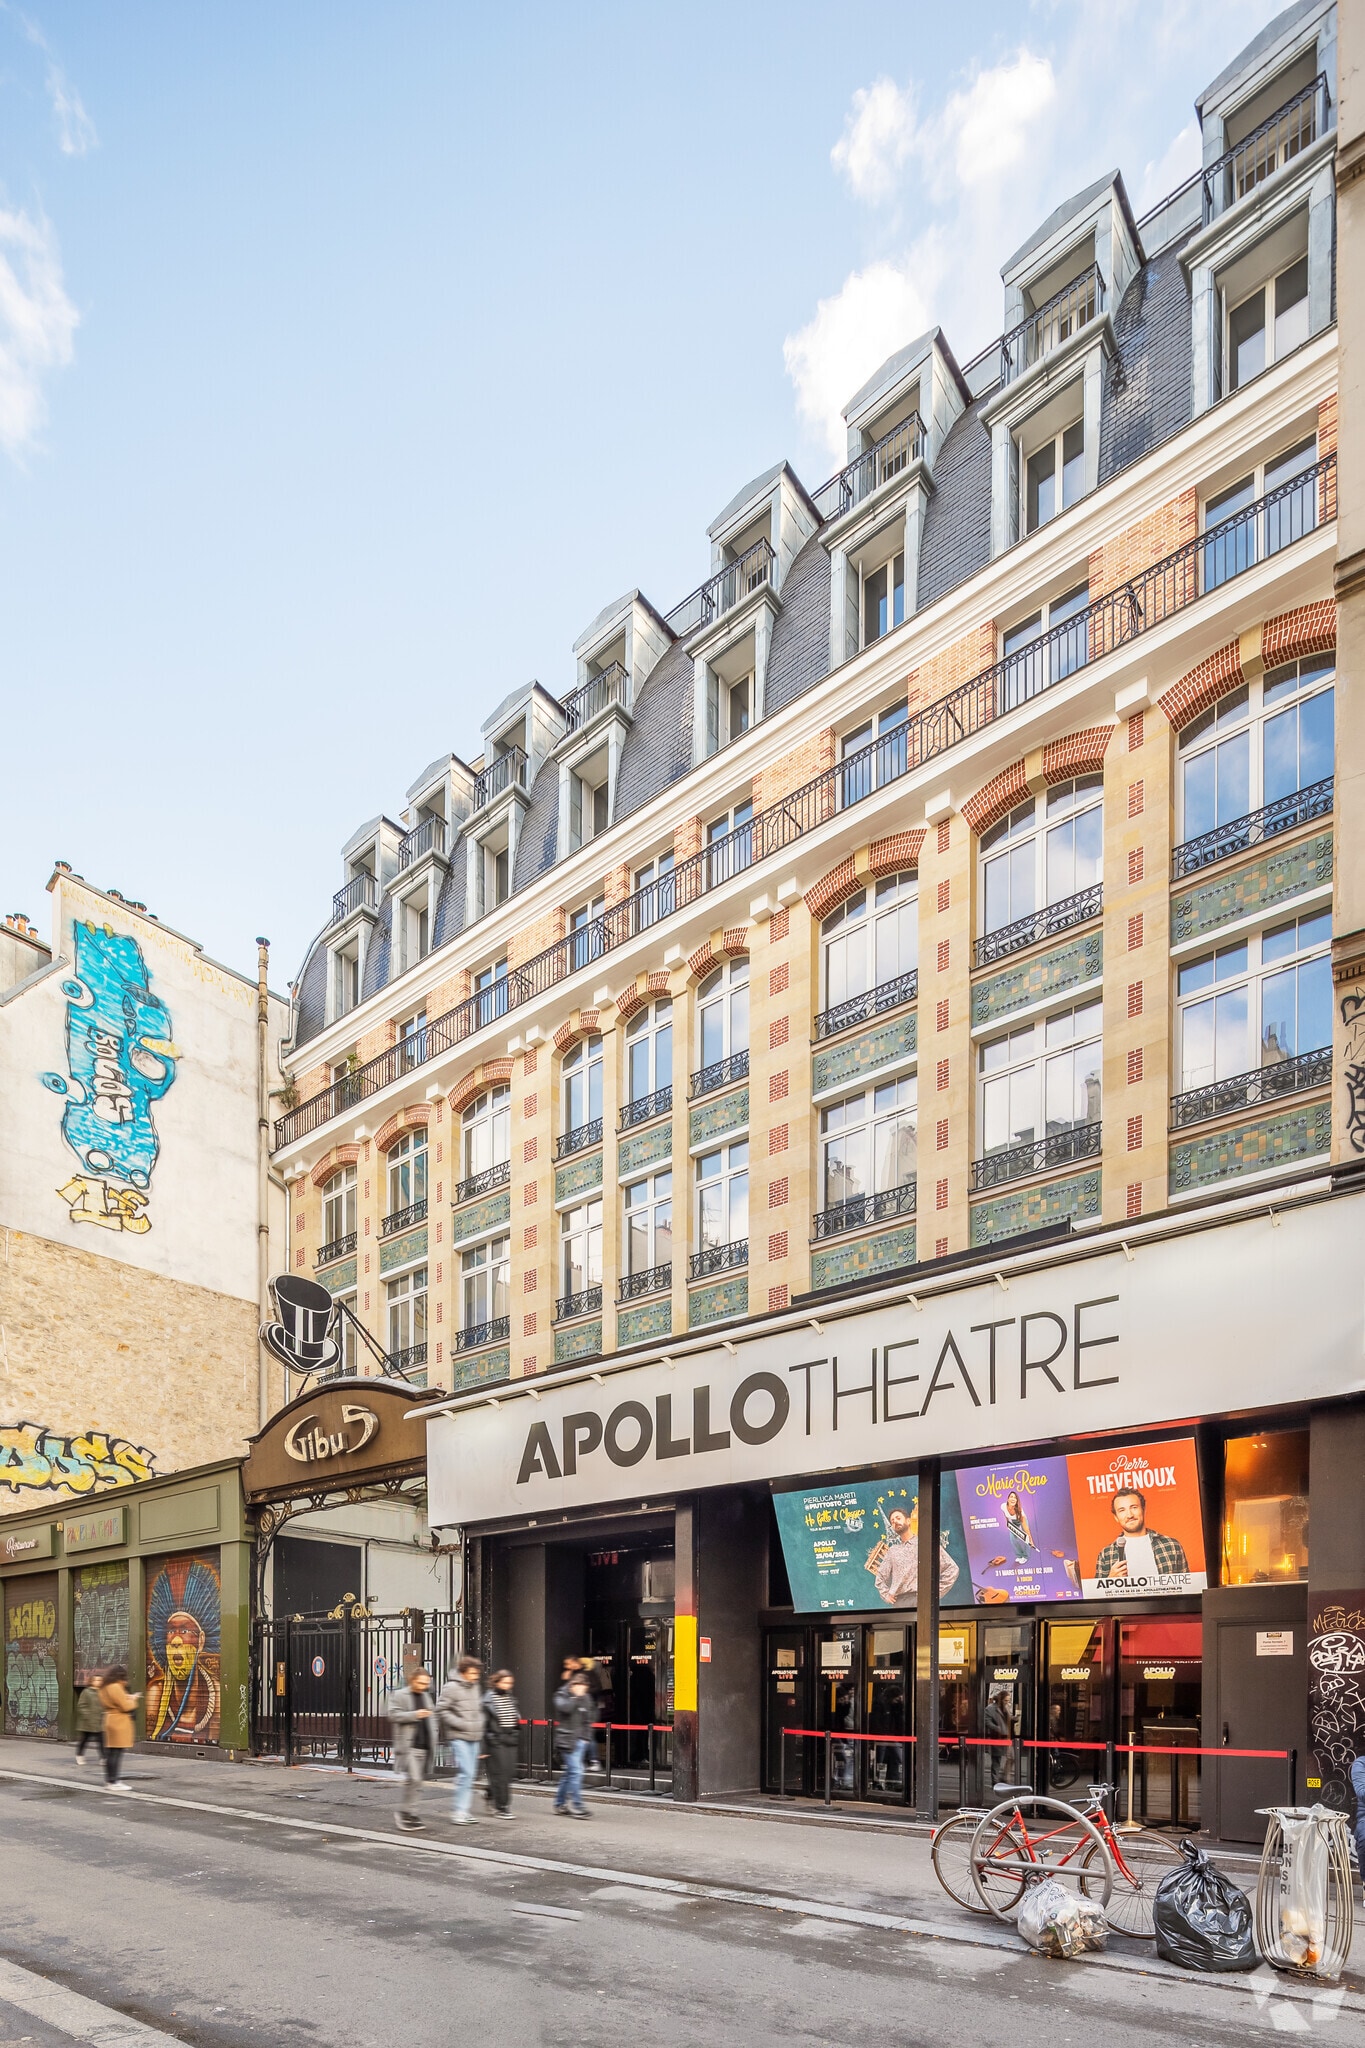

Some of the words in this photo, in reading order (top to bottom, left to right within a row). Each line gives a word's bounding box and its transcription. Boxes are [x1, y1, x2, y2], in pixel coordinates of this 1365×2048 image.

[1109, 1454, 1149, 1472] Pierre
[976, 1474, 1014, 1498] Marie
[1014, 1470, 1048, 1494] Reno
[1086, 1466, 1176, 1494] THEVENOUX
[804, 1495, 834, 1504] PIERLUCA
[590, 1553, 618, 1566] LIVE
